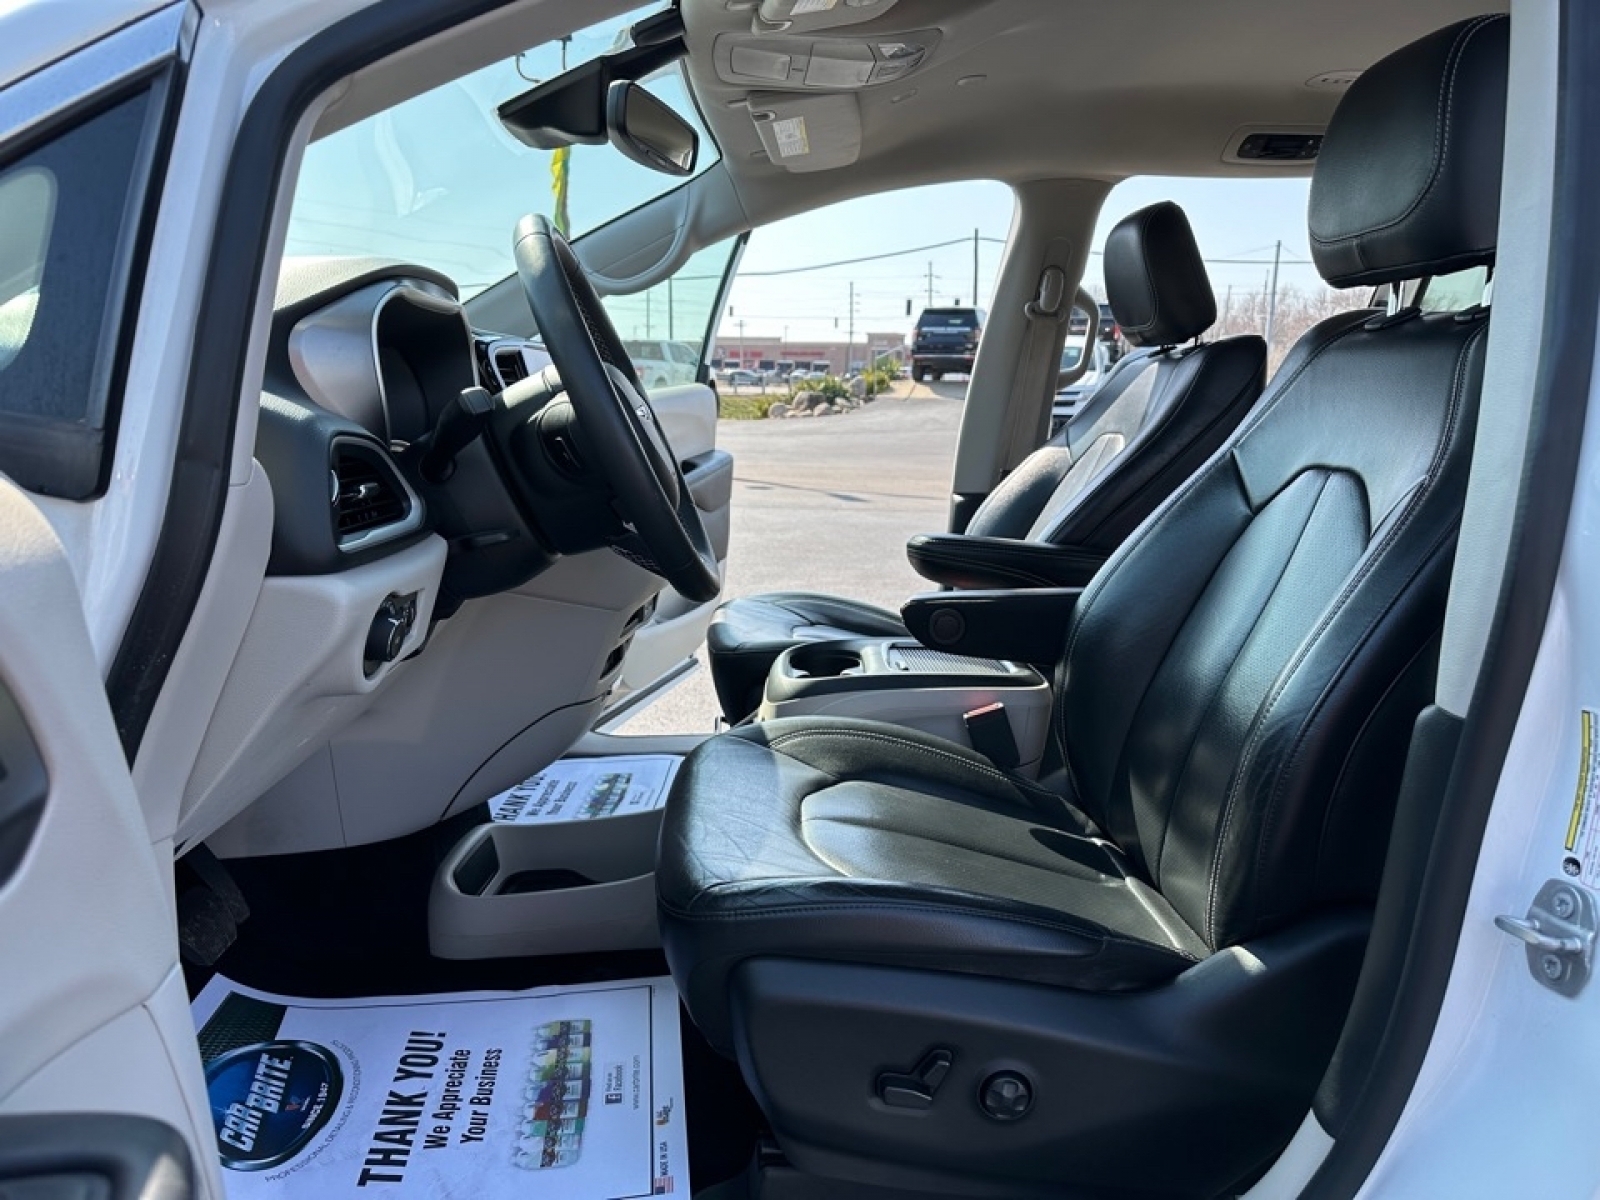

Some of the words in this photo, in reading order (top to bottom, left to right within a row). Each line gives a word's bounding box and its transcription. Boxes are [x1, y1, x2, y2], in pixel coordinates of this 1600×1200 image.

[493, 794, 532, 821] HANK
[219, 1102, 263, 1152] CAR
[245, 1053, 292, 1114] BRITE
[431, 1050, 471, 1121] Appreciate
[469, 1048, 502, 1105] Business
[357, 1089, 428, 1187] THANK
[393, 1031, 446, 1082] YOU!
[423, 1125, 450, 1149] We
[460, 1110, 489, 1143] Your
